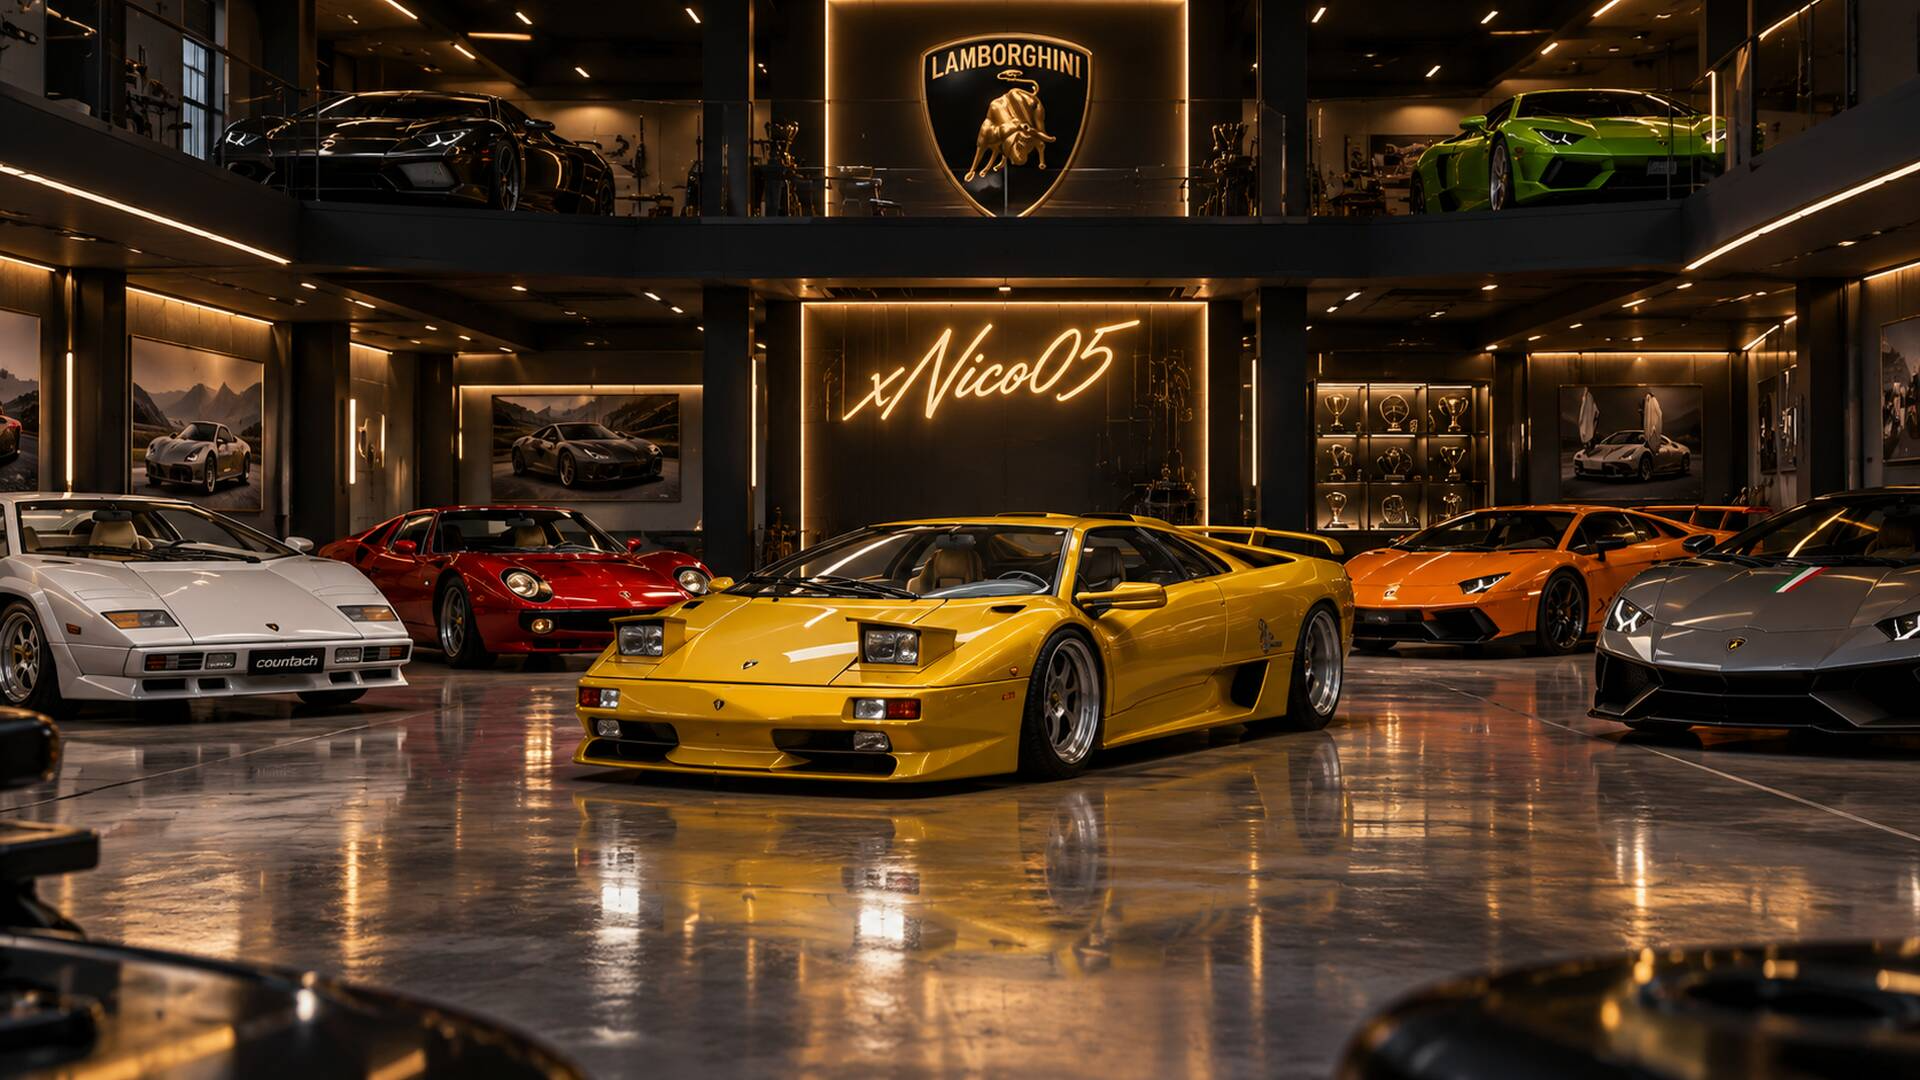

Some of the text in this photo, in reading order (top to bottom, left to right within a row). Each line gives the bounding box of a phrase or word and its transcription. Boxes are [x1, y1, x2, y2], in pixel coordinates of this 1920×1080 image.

[932, 43, 1081, 80] LAMBORGHINI
[842, 319, 1140, 421] xNico05
[256, 655, 319, 668] countach
